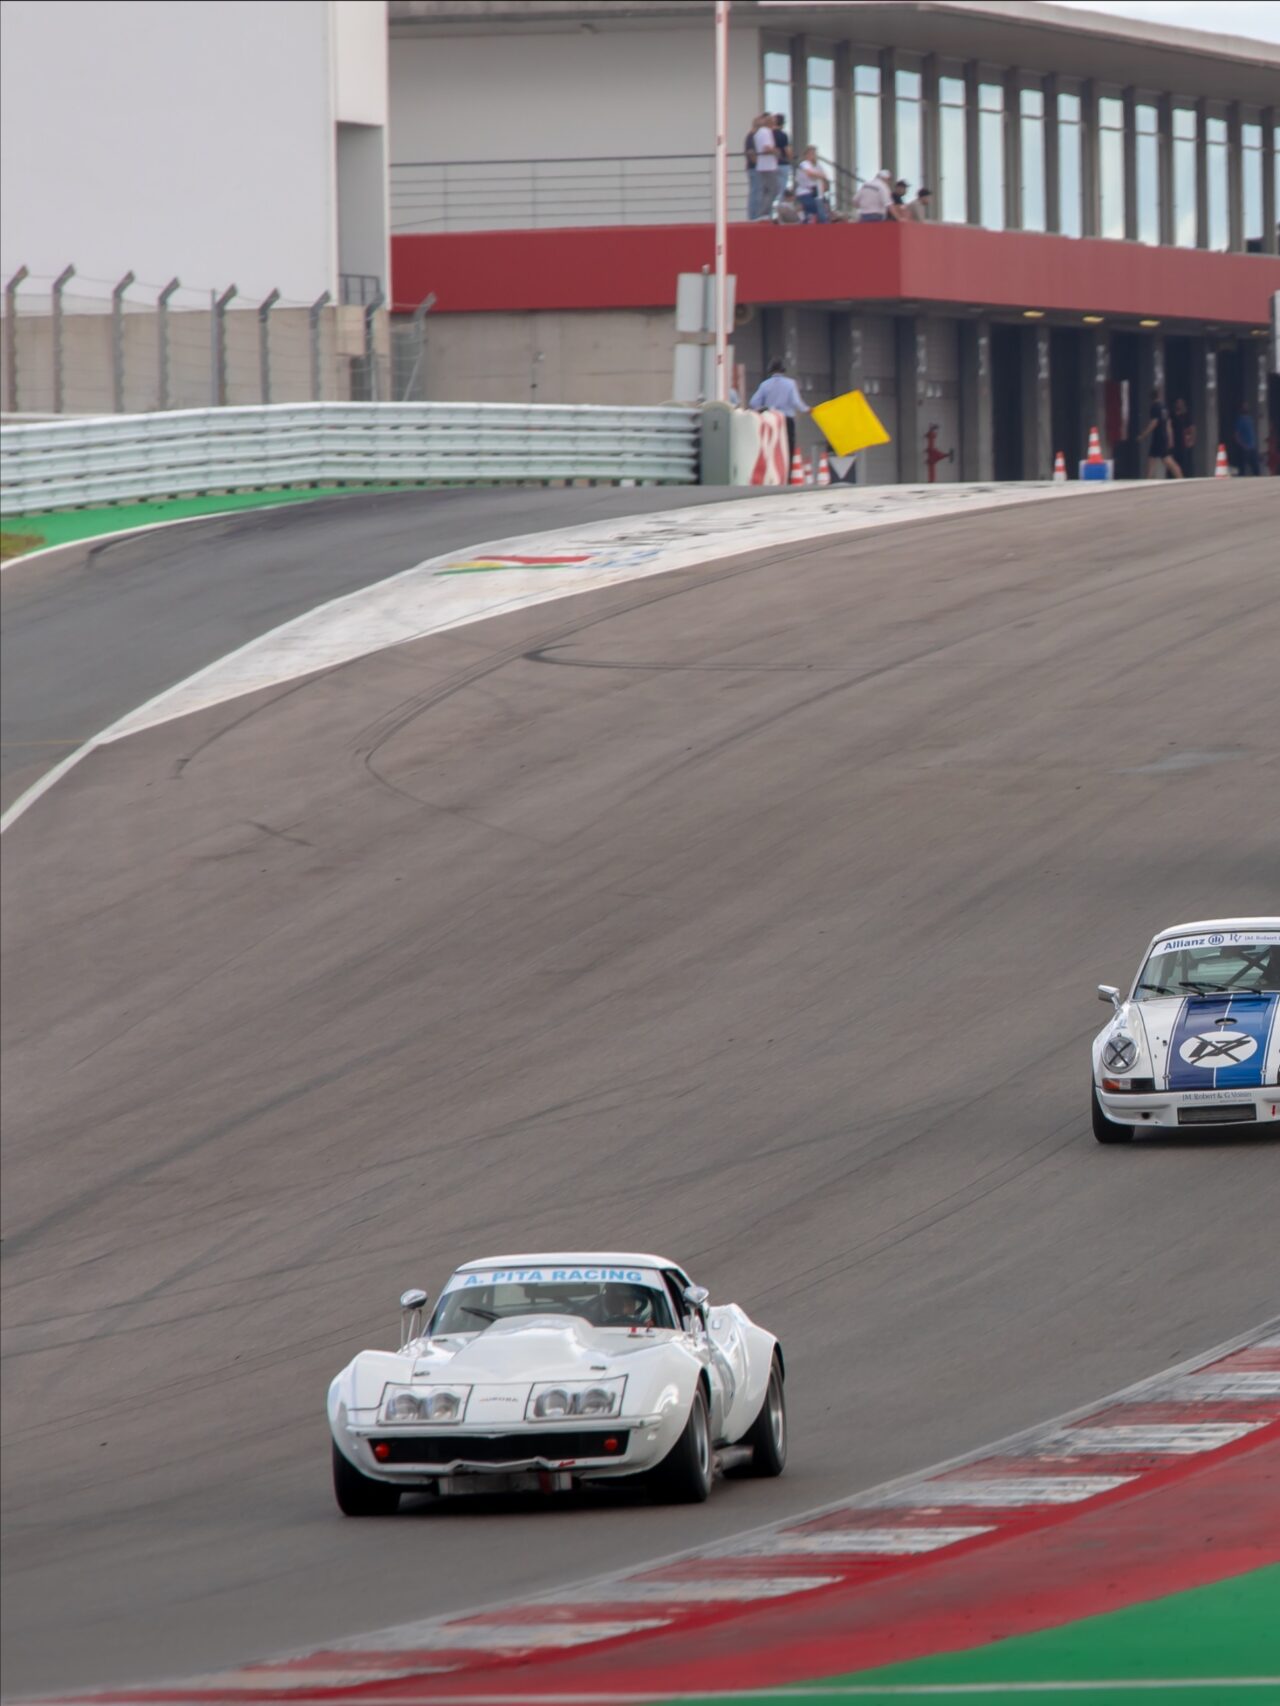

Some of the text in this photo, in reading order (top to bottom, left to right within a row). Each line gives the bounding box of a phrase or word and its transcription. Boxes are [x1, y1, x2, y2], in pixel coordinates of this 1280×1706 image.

[1163, 937, 1206, 951] Allianz
[492, 1270, 544, 1283] PITA
[552, 1269, 642, 1282] RACING
